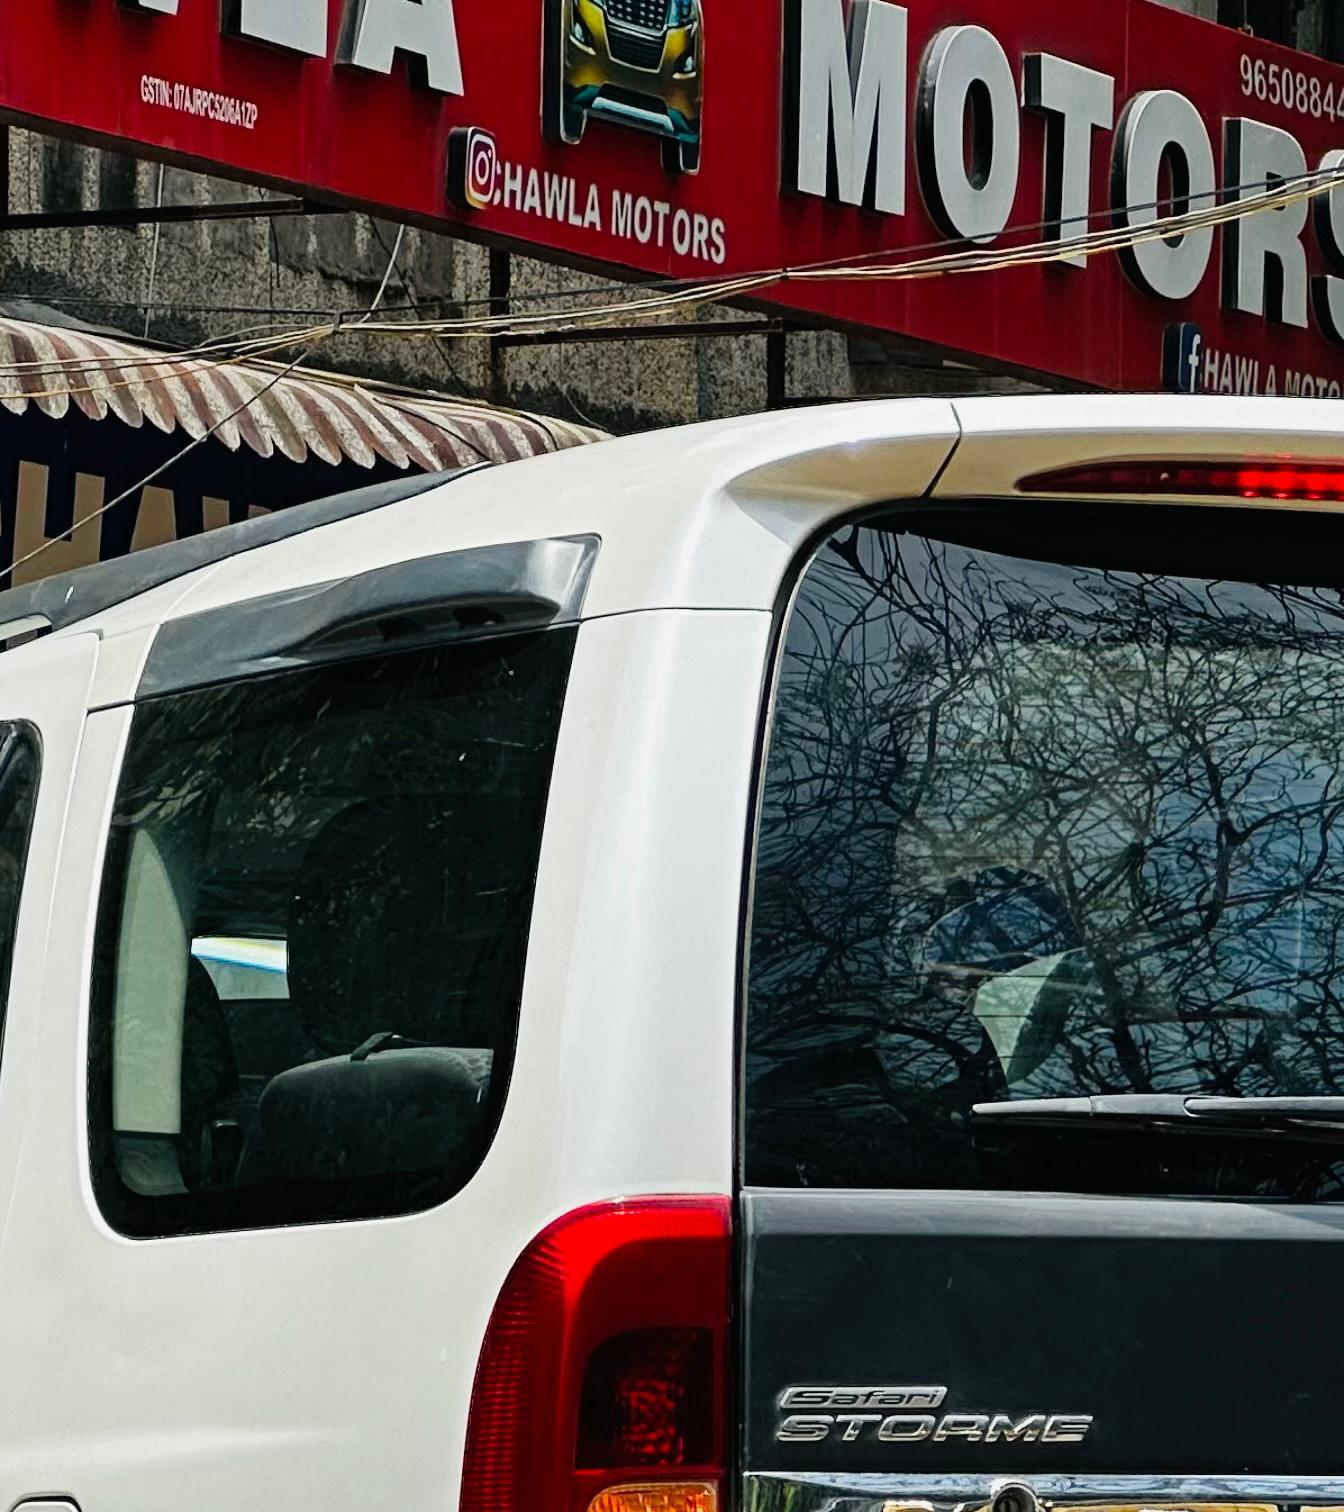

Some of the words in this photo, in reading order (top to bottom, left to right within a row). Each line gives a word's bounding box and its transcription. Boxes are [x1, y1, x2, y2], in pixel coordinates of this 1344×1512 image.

[611, 189, 726, 264] MOTORS
[781, 1387, 946, 1408] Safari
[777, 1414, 1093, 1442] STORME
